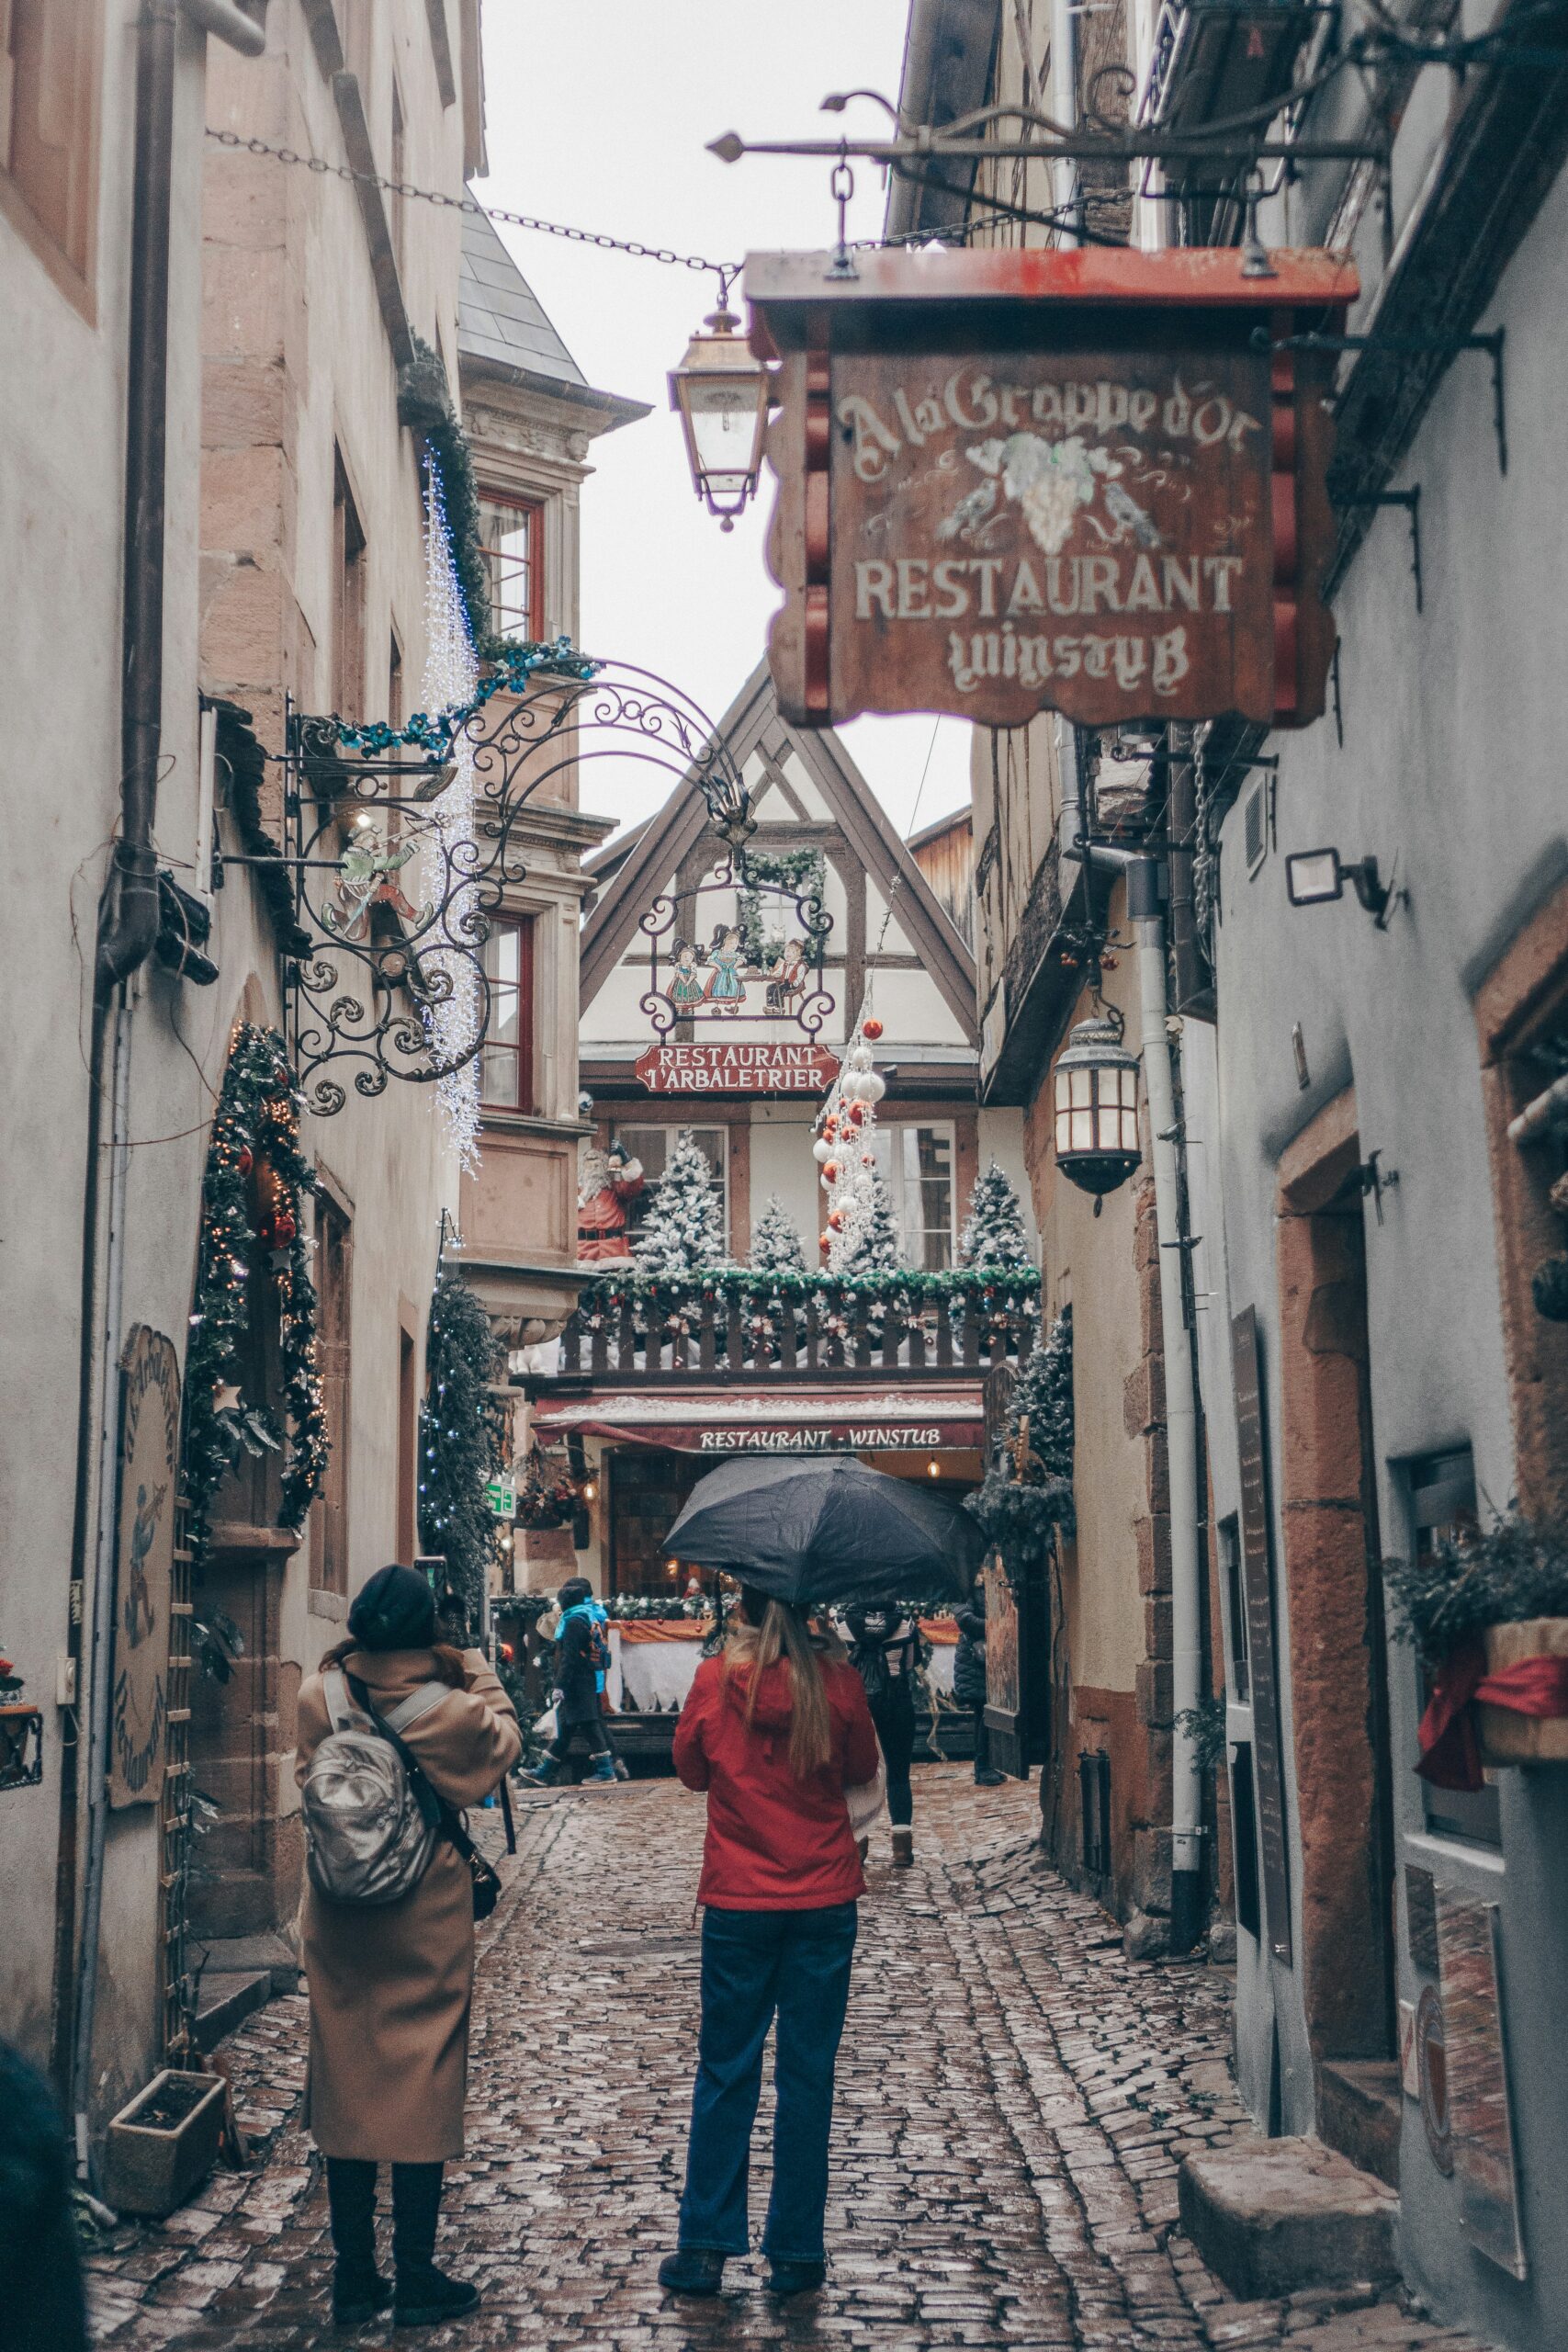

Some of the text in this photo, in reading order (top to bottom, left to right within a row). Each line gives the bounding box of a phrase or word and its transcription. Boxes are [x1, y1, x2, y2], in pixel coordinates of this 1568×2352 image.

[837, 395, 902, 482] A
[943, 368, 1158, 435] Grappe
[853, 555, 1244, 621] RESTAURANT
[658, 1047, 817, 1069] RESTAURANT
[700, 1430, 831, 1448] RESTAURANT
[849, 1428, 941, 1445] WINSTUB
